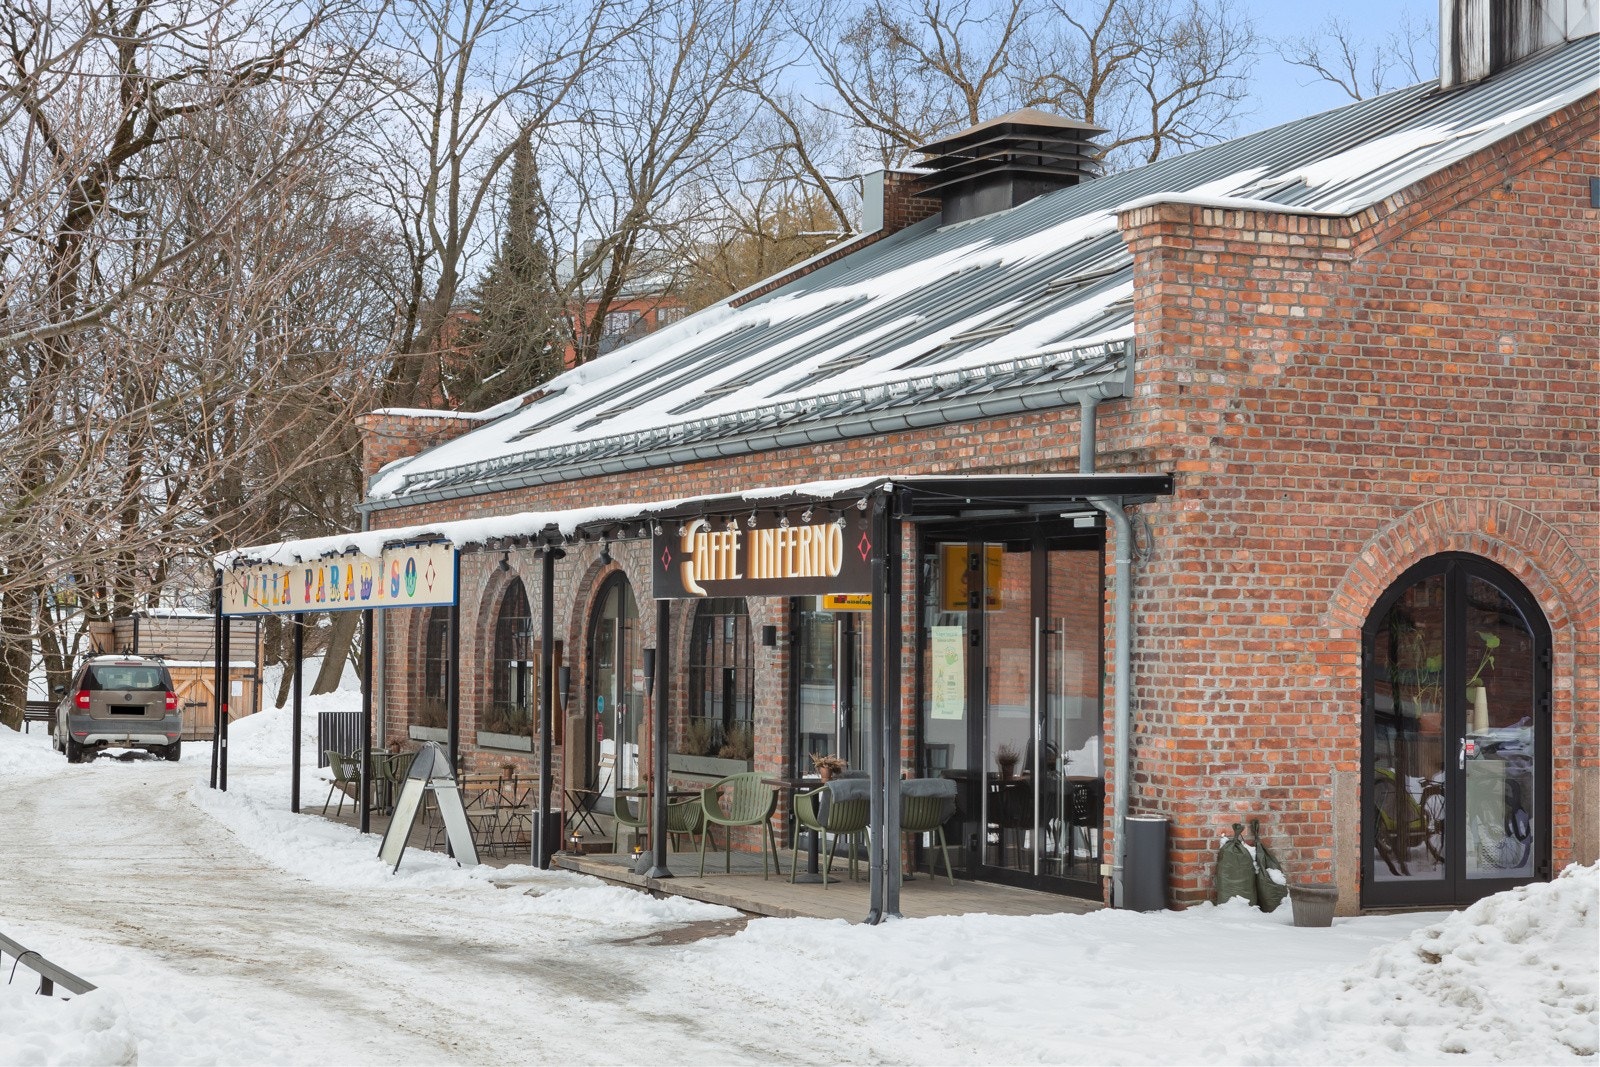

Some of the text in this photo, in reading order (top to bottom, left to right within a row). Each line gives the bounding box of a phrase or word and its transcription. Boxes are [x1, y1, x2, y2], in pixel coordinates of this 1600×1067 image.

[747, 523, 843, 578] INFERNO
[242, 557, 417, 607] VILLA PARADISO
